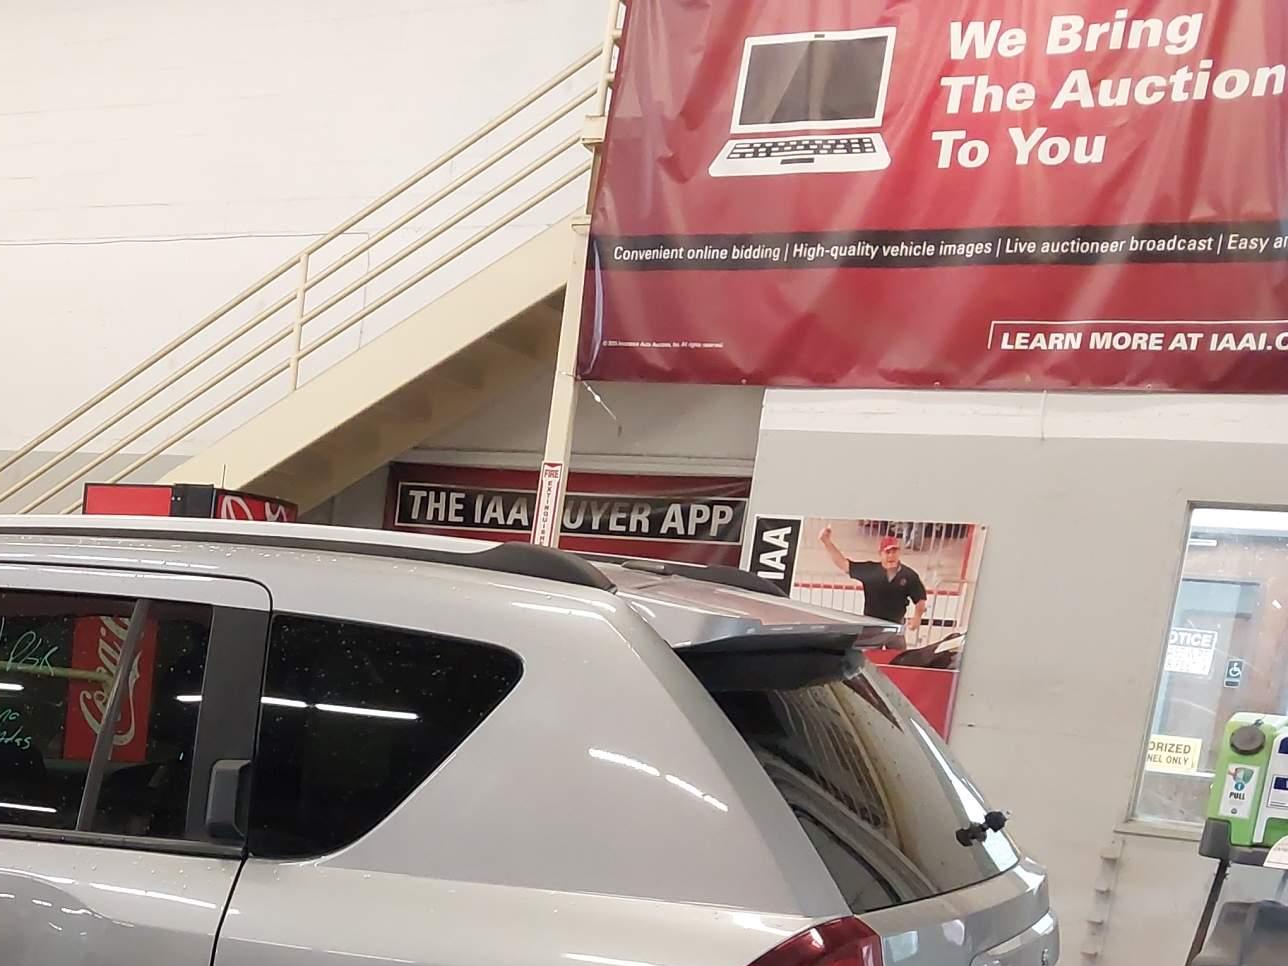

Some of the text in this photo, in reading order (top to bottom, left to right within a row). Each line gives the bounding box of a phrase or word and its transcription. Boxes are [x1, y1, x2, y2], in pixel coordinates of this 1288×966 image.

[949, 8, 1204, 60] We Bring
[939, 59, 1287, 114] The Auction
[931, 127, 1107, 169] To You
[613, 246, 686, 261] Convenient
[687, 246, 729, 260] online
[731, 245, 781, 262] bidding
[793, 241, 879, 261] High-quality
[882, 240, 935, 257] vehicle
[938, 239, 992, 258] images
[1005, 238, 1037, 254] Live
[1040, 236, 1126, 254] auctioneer
[1129, 235, 1214, 251] broadcast
[1227, 233, 1269, 253] Easy
[1001, 332, 1083, 350] LEARN
[1089, 332, 1165, 350] MORE
[1168, 332, 1203, 350] AT
[543, 469, 559, 479] FIRE
[408, 489, 736, 537] THE IAA UYER APP
[539, 480, 553, 545] EXTINGUISH
[757, 526, 792, 580] IAA
[1168, 631, 1214, 649] OTICE
[1149, 741, 1192, 754] ORIZED
[1166, 755, 1190, 766] ONLY
[1228, 791, 1246, 801] PULL
